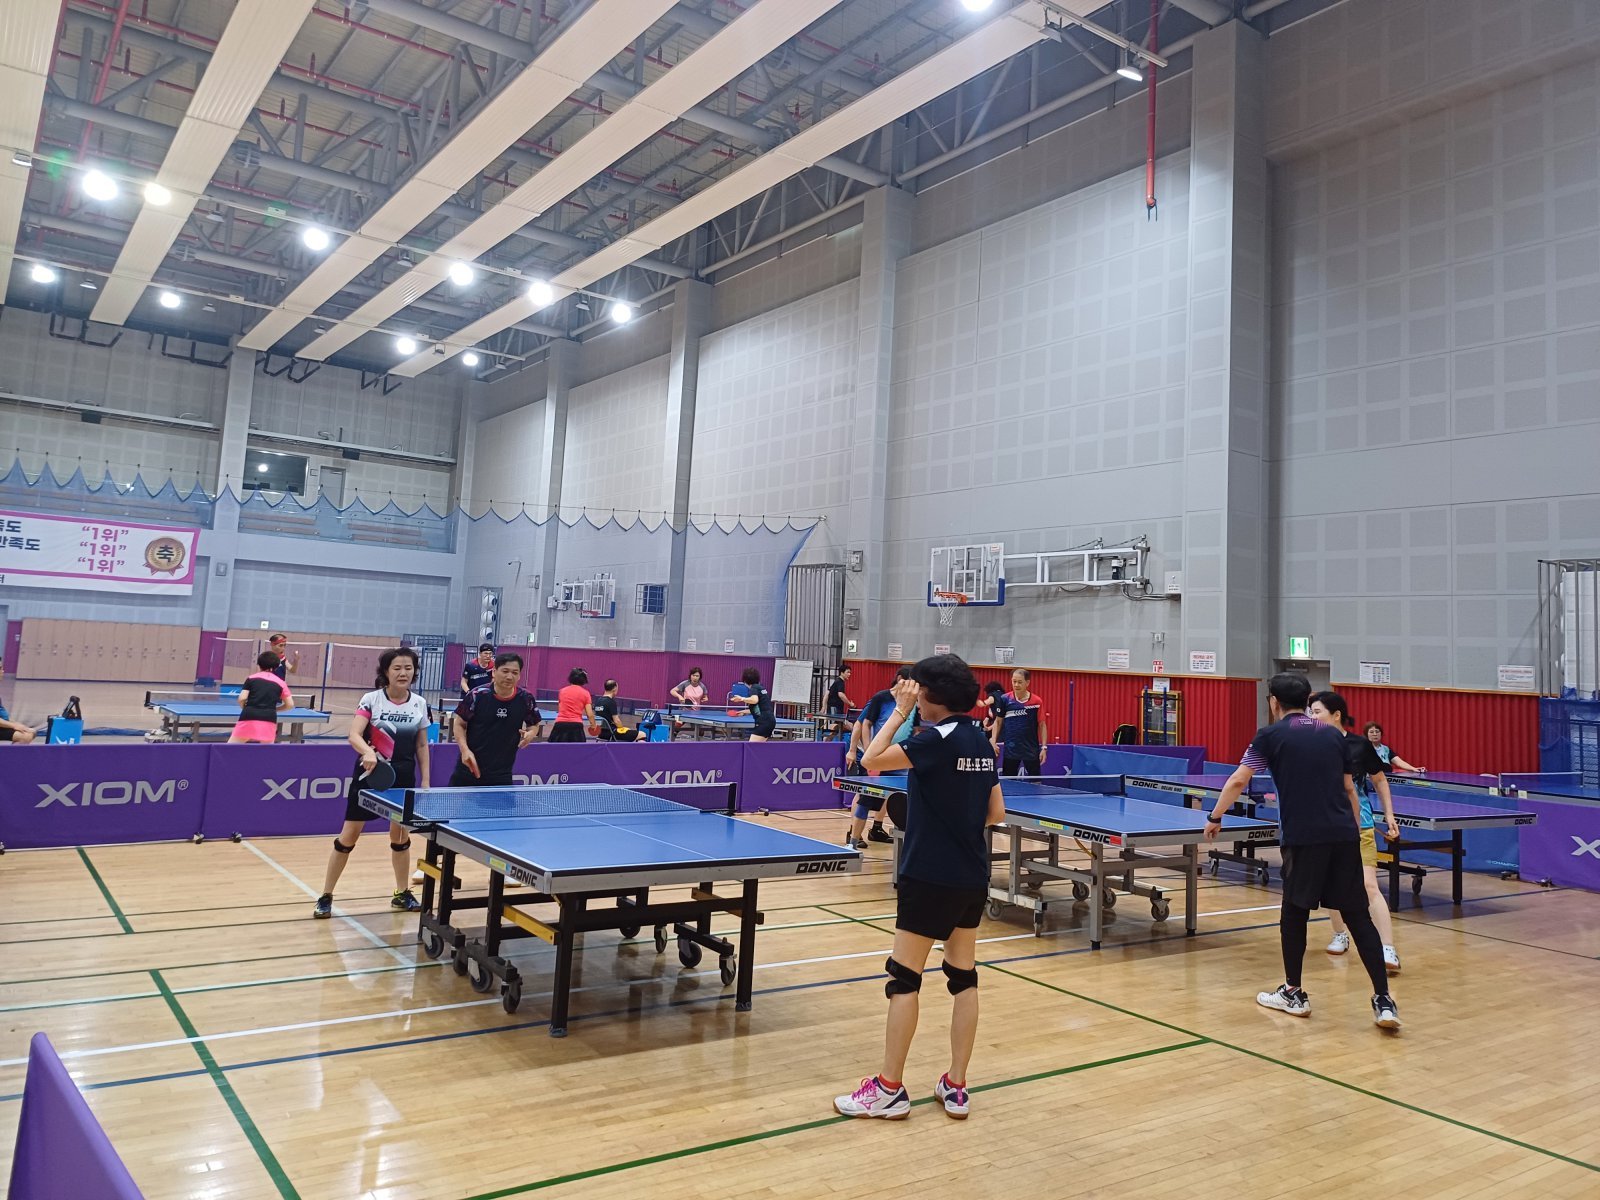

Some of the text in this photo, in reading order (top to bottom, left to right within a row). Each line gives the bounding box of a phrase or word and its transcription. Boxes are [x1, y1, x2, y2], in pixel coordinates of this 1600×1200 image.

[156, 544, 175, 563] 축
[260, 777, 353, 801] XIO
[839, 782, 863, 793] DONIC
[1132, 780, 1159, 789] DONIC
[1073, 829, 1111, 843] DONIC
[1248, 830, 1276, 839] DONIC
[796, 860, 848, 874] DONIC
[510, 865, 538, 887] DONIC
